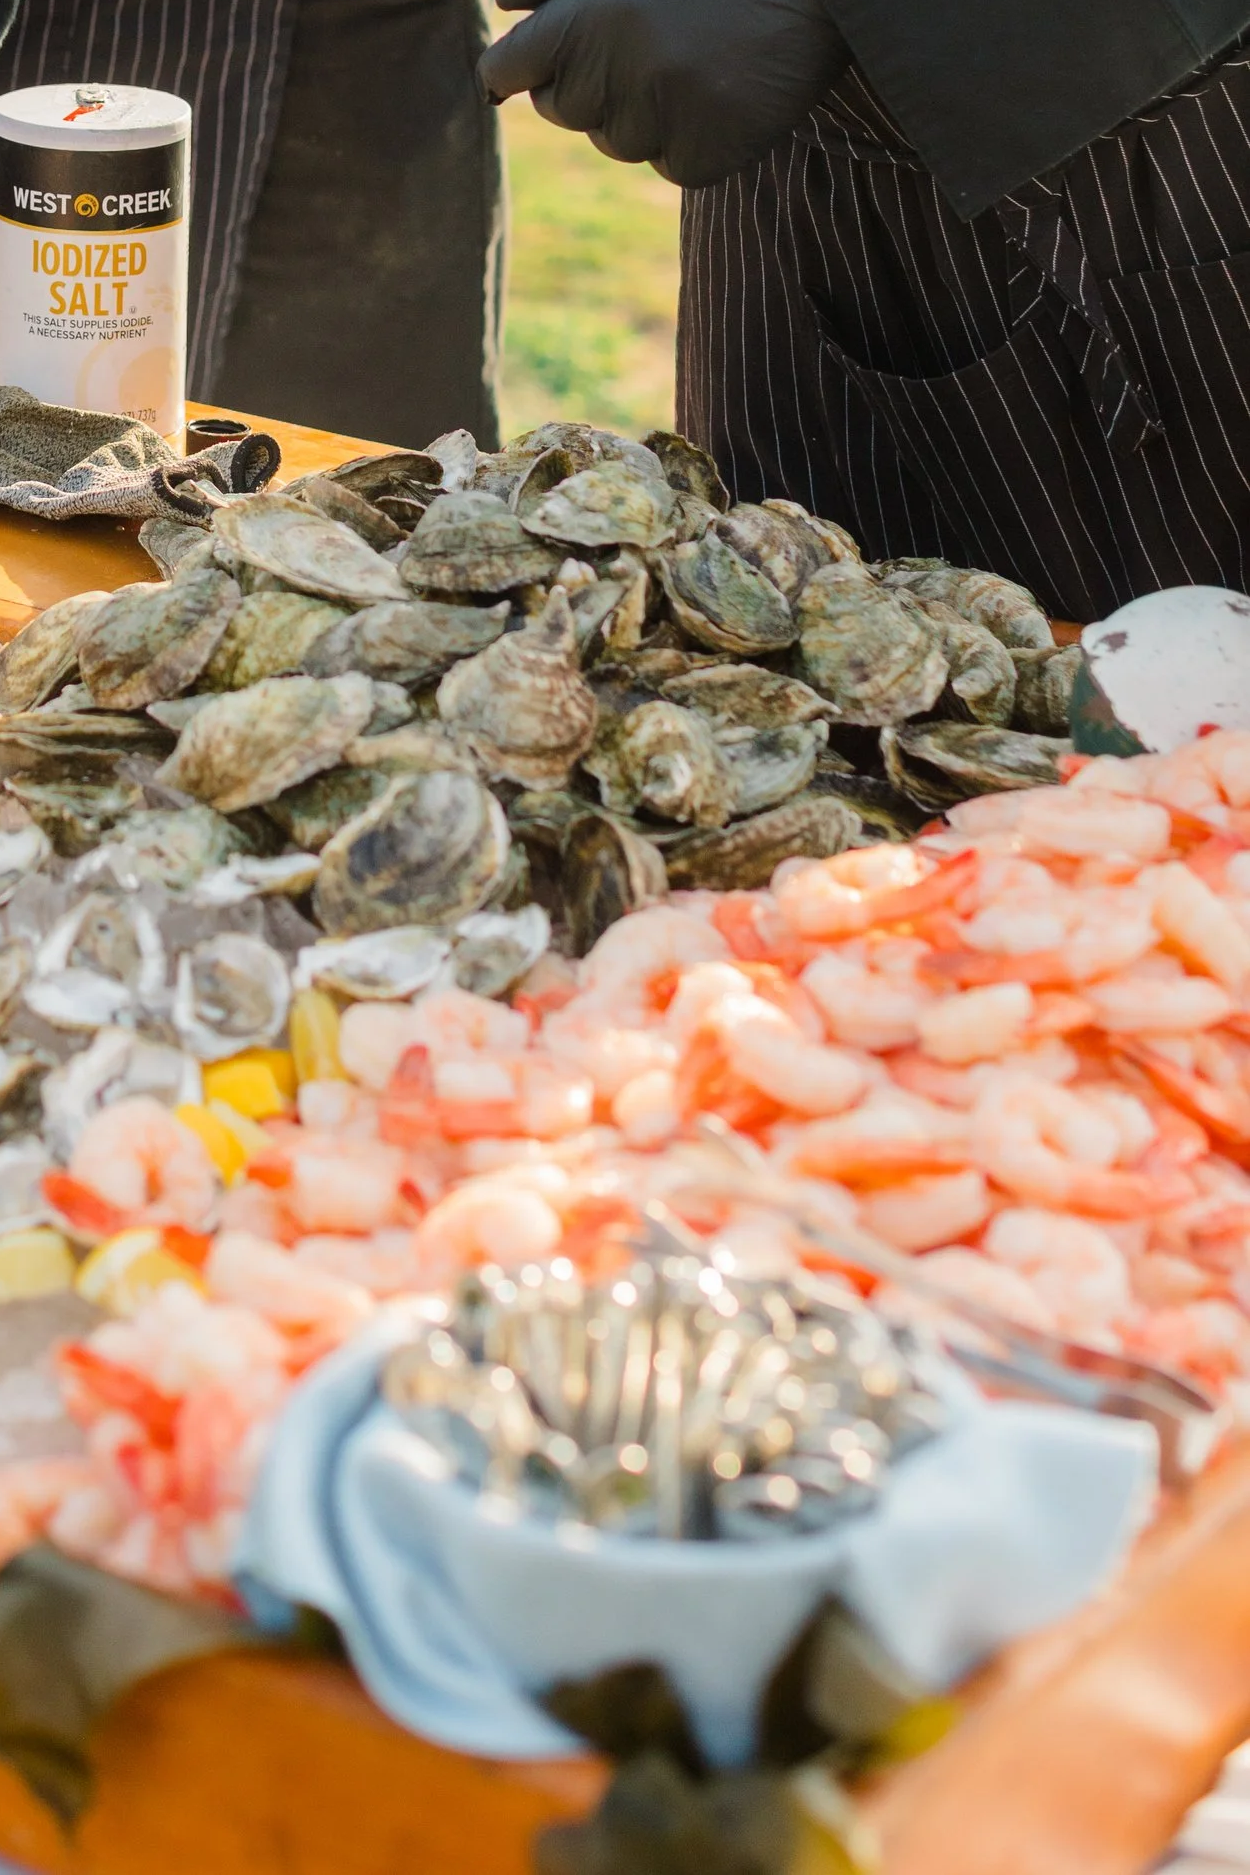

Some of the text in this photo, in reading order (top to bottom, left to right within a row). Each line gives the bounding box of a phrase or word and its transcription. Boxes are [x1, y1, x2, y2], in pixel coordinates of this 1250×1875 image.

[13, 185, 171, 216] WEST CREEK
[32, 239, 147, 277] IODIZED
[49, 281, 129, 316] SALT
[23, 312, 154, 329] THIS SALT SUPPLIES IODIDE,
[28, 326, 148, 340] A NECESSARY NUTRIENT
[138, 408, 157, 423] 737g
